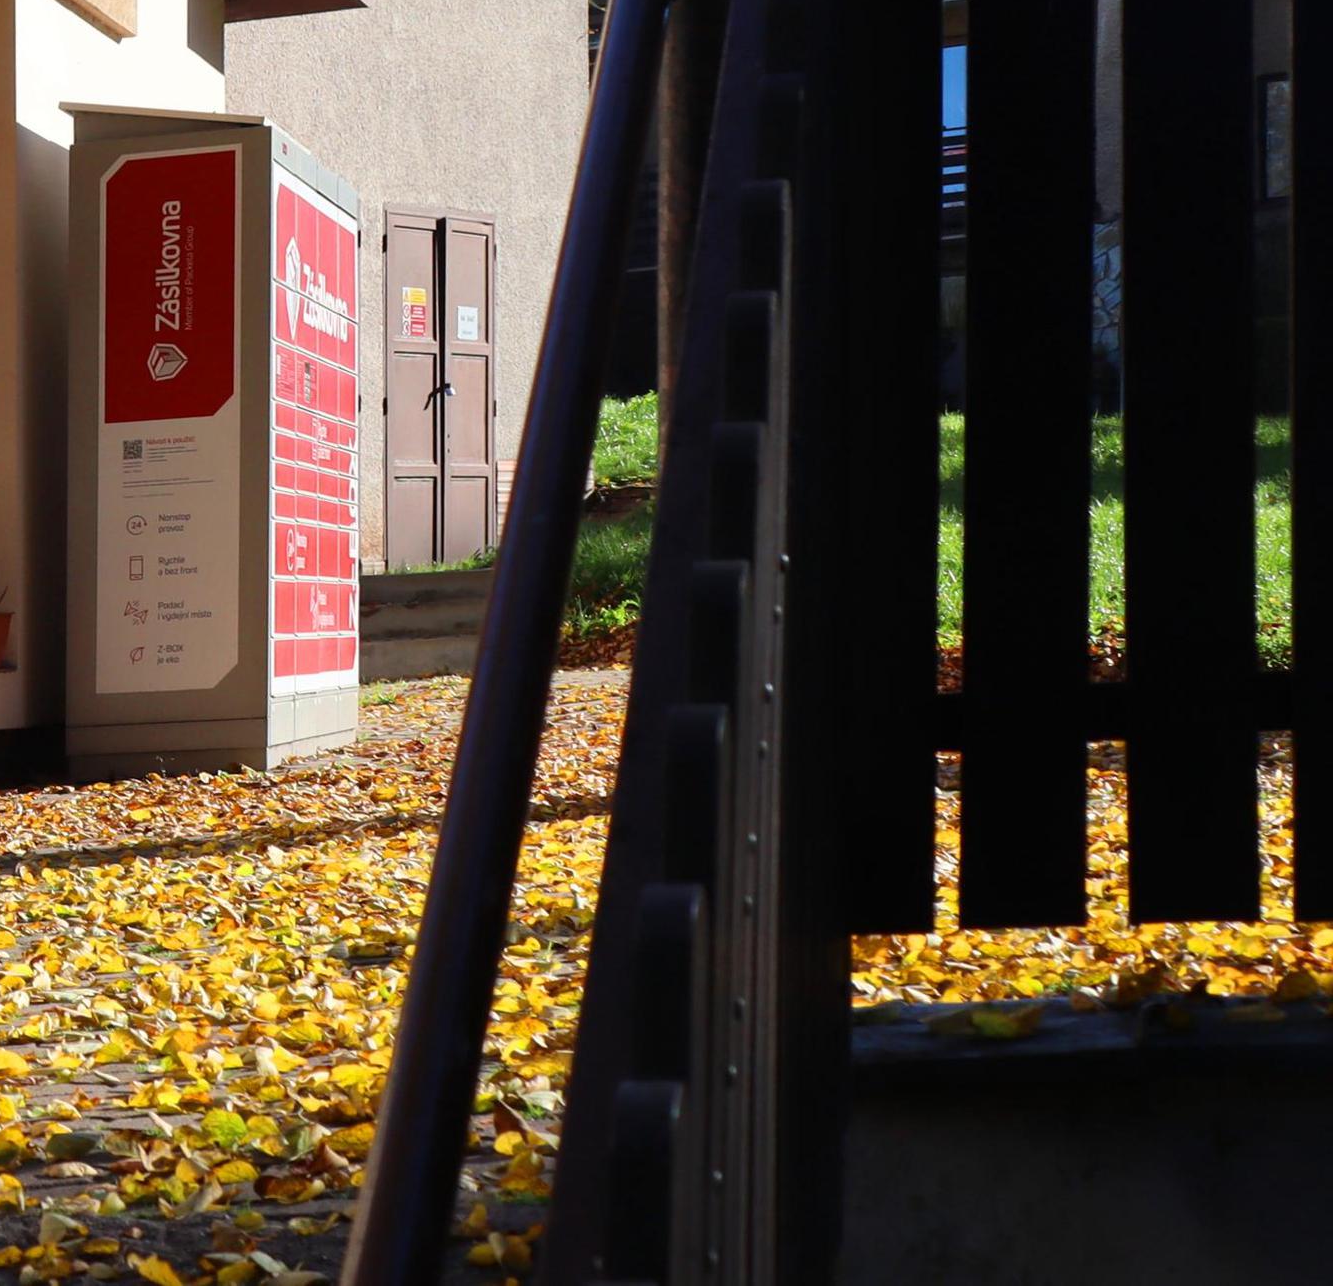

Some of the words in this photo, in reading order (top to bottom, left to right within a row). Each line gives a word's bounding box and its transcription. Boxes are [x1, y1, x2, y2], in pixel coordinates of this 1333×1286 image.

[154, 199, 181, 332] Zásilkovna
[158, 513, 191, 524] Nonstop
[158, 525, 184, 534] provoz
[158, 556, 186, 566] Rychle
[164, 567, 179, 576] bez
[157, 644, 184, 654] Z-BOX
